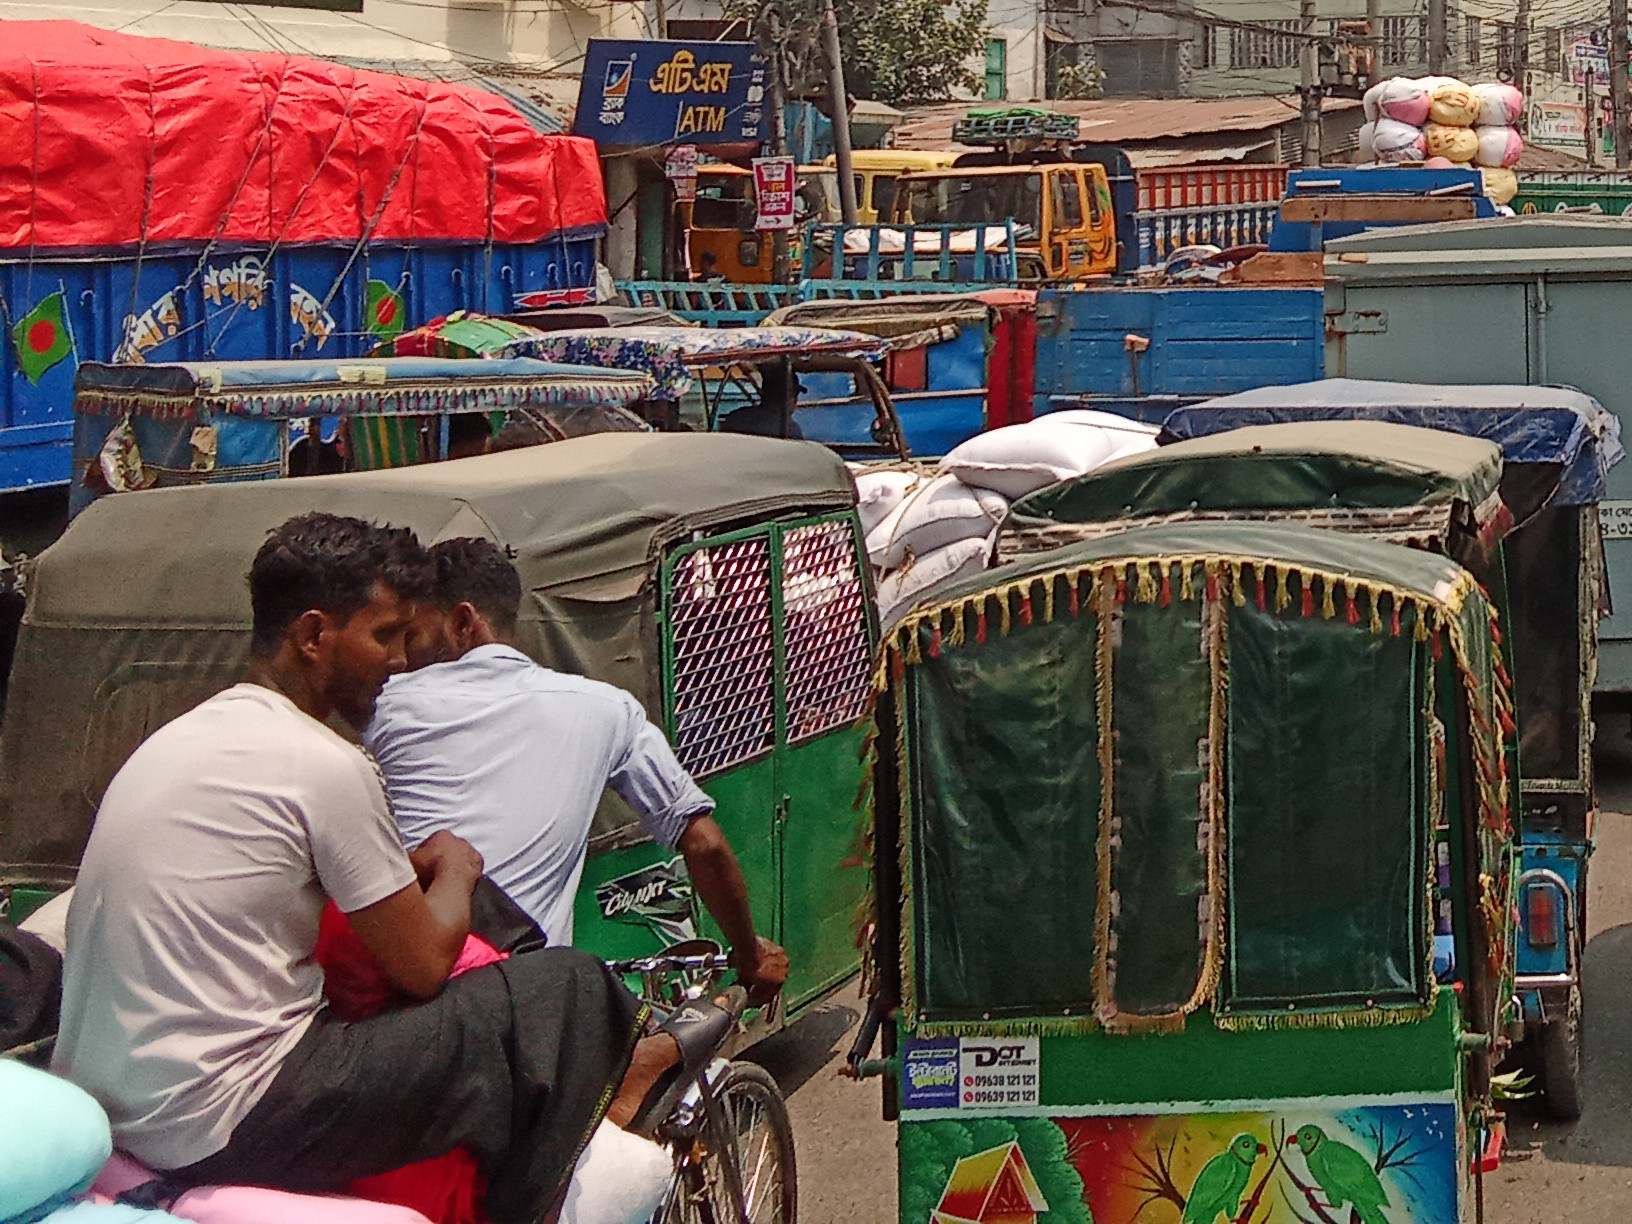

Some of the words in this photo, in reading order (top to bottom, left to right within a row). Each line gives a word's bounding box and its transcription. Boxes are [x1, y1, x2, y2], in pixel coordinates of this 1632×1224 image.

[649, 49, 732, 95] এটিএম
[679, 106, 726, 133] ATM
[962, 1045, 1026, 1067] DOT
[1007, 1075, 1020, 1086] 121
[1022, 1074, 1036, 1086] 121
[974, 1091, 1005, 1103] 09639
[1007, 1091, 1020, 1103] 121
[1022, 1090, 1036, 1102] 121
